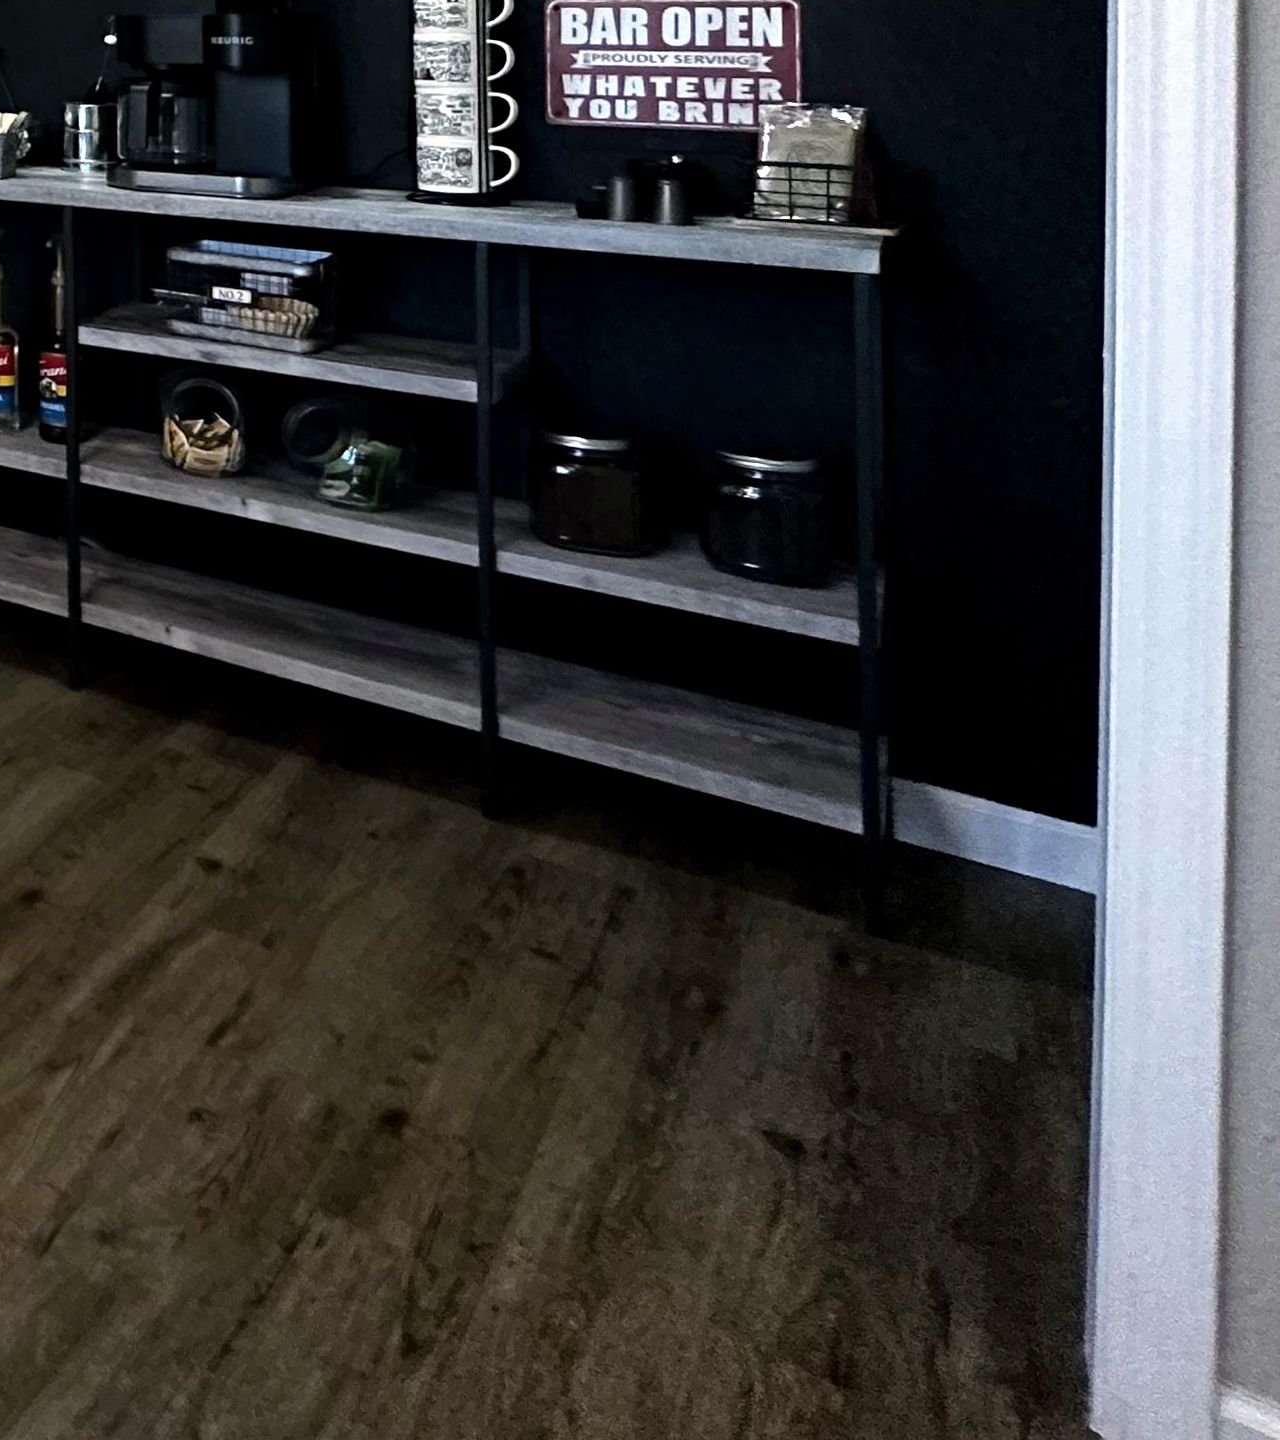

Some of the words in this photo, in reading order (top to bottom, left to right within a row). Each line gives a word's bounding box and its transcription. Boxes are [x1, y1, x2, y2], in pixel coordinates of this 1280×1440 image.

[560, 6, 649, 46] BAR
[661, 6, 784, 48] OPEN
[591, 52, 669, 65] PROUDLY
[673, 53, 749, 67] SERVING
[561, 73, 784, 101] WHATEVER
[563, 97, 638, 120] YOU
[658, 100, 754, 125] BRIN
